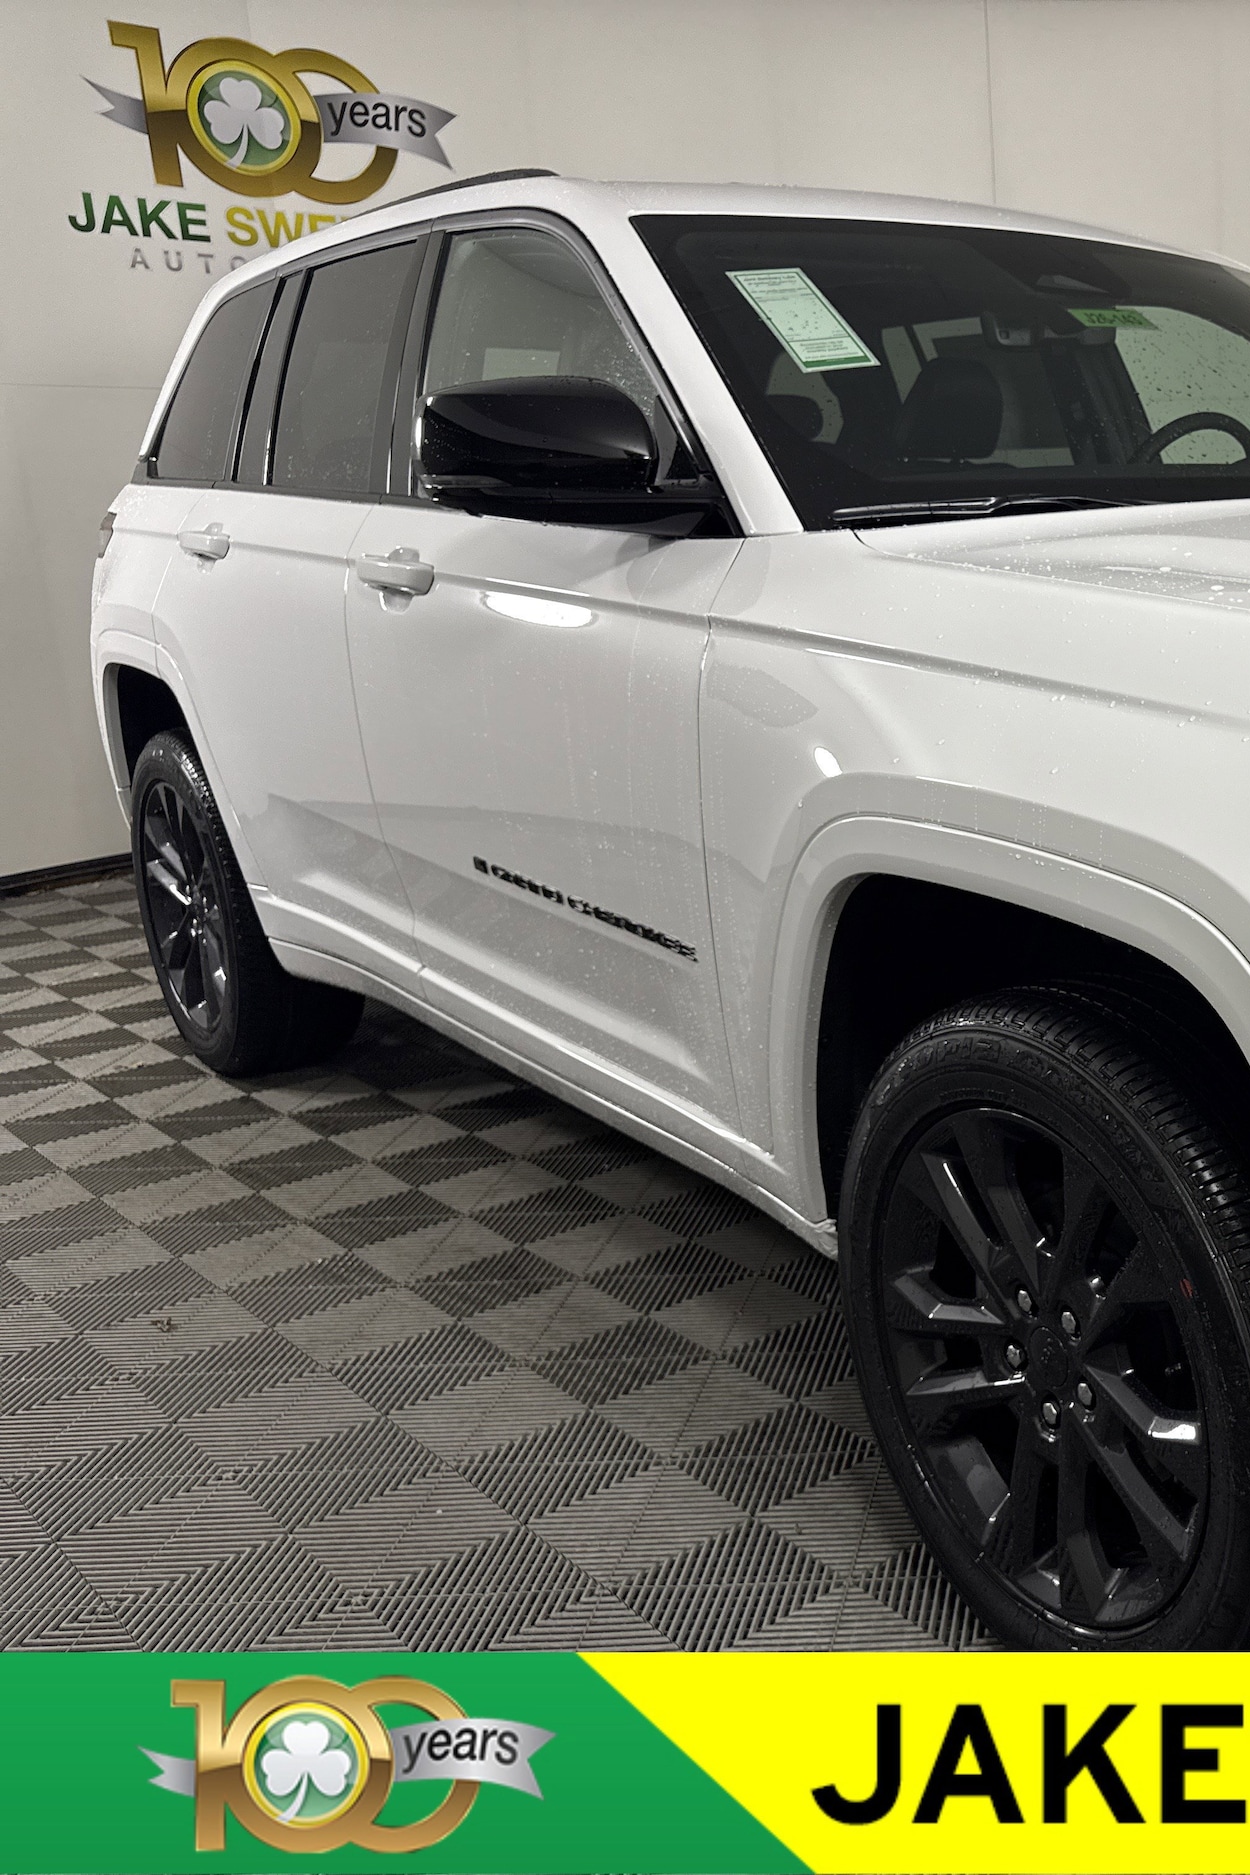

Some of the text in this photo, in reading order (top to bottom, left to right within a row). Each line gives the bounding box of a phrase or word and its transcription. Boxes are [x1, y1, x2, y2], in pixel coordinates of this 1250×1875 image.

[107, 20, 427, 205] 100 years
[68, 191, 212, 243] JAKE
